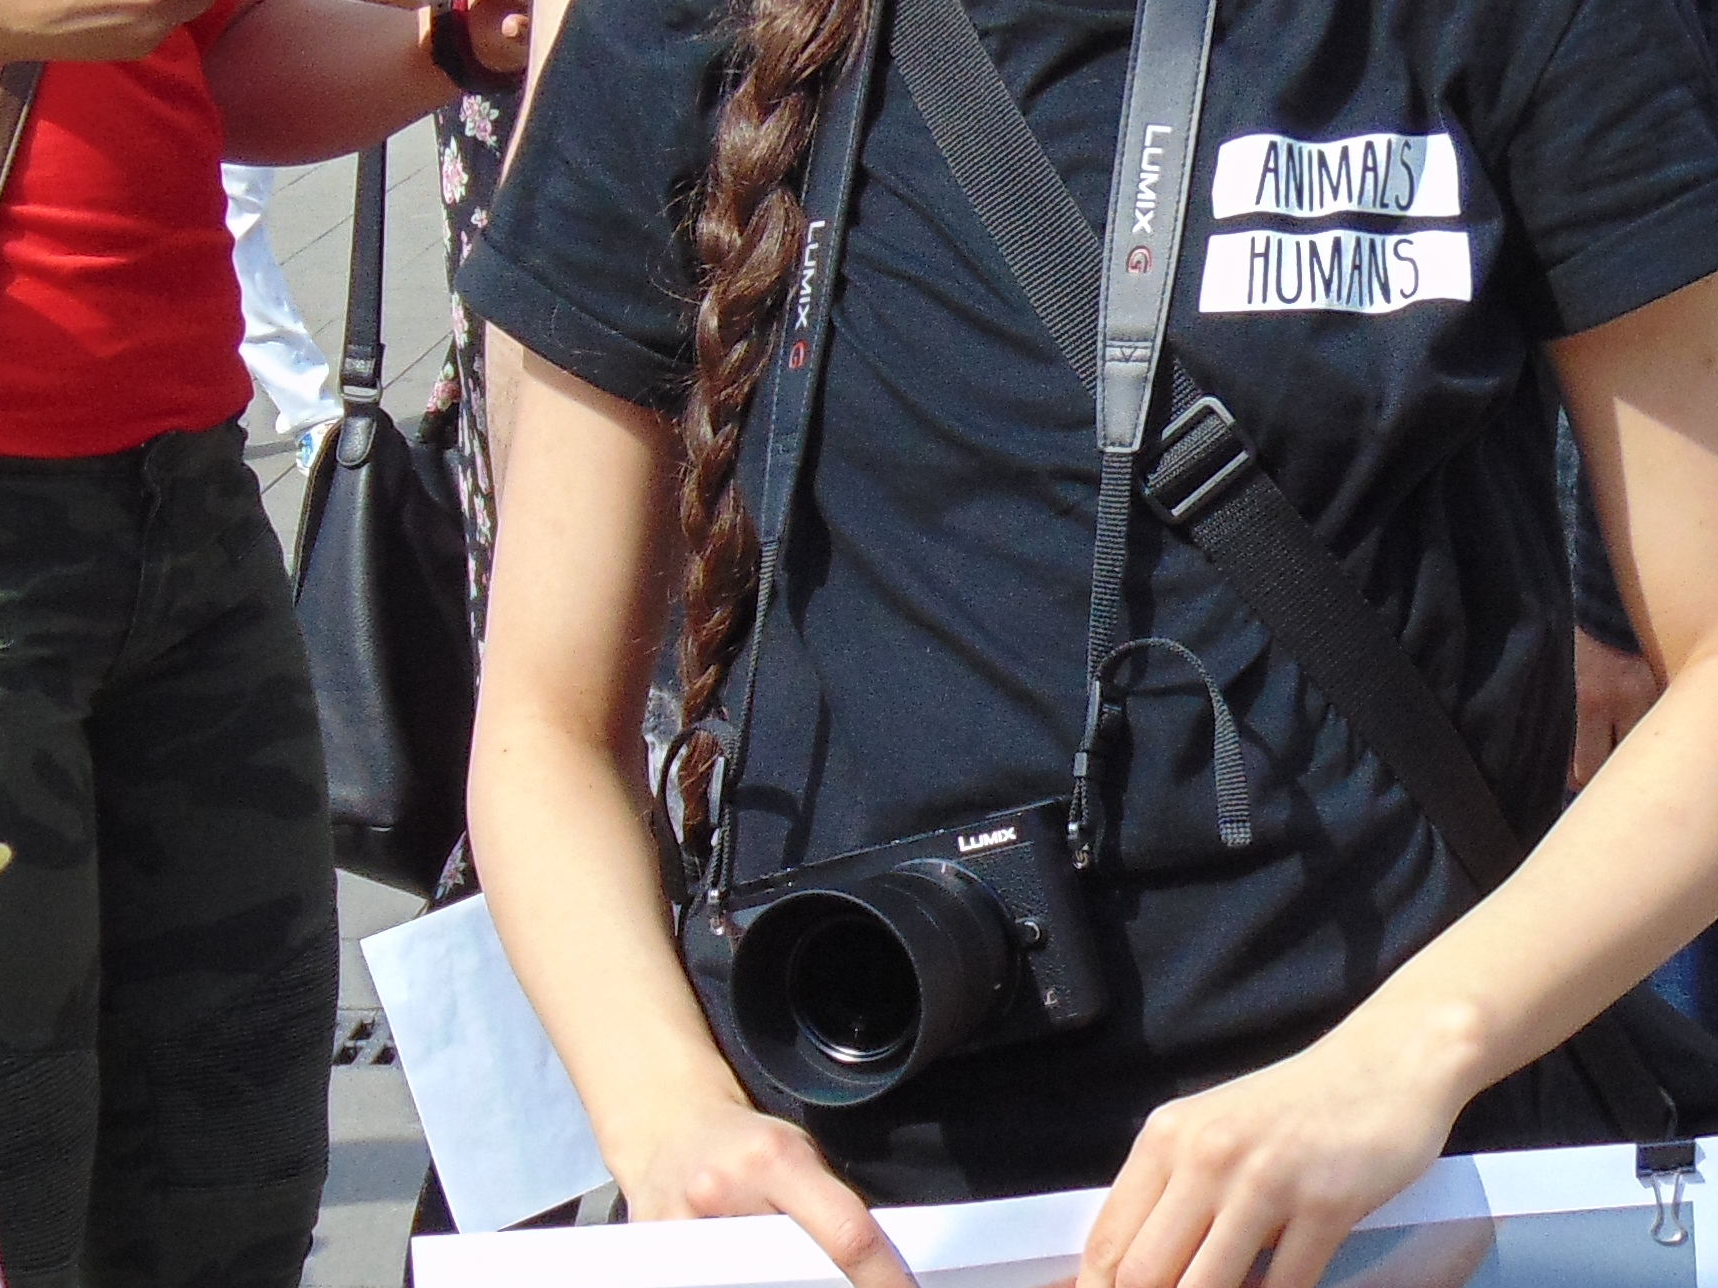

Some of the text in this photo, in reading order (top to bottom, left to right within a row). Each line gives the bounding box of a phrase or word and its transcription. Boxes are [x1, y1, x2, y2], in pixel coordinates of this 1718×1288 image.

[1132, 125, 1173, 234] LUMIX
[1254, 138, 1415, 212] ANIMALS
[794, 220, 826, 331] LUMIX
[1247, 235, 1419, 307] HUMANS
[958, 826, 1017, 852] LUMIX
